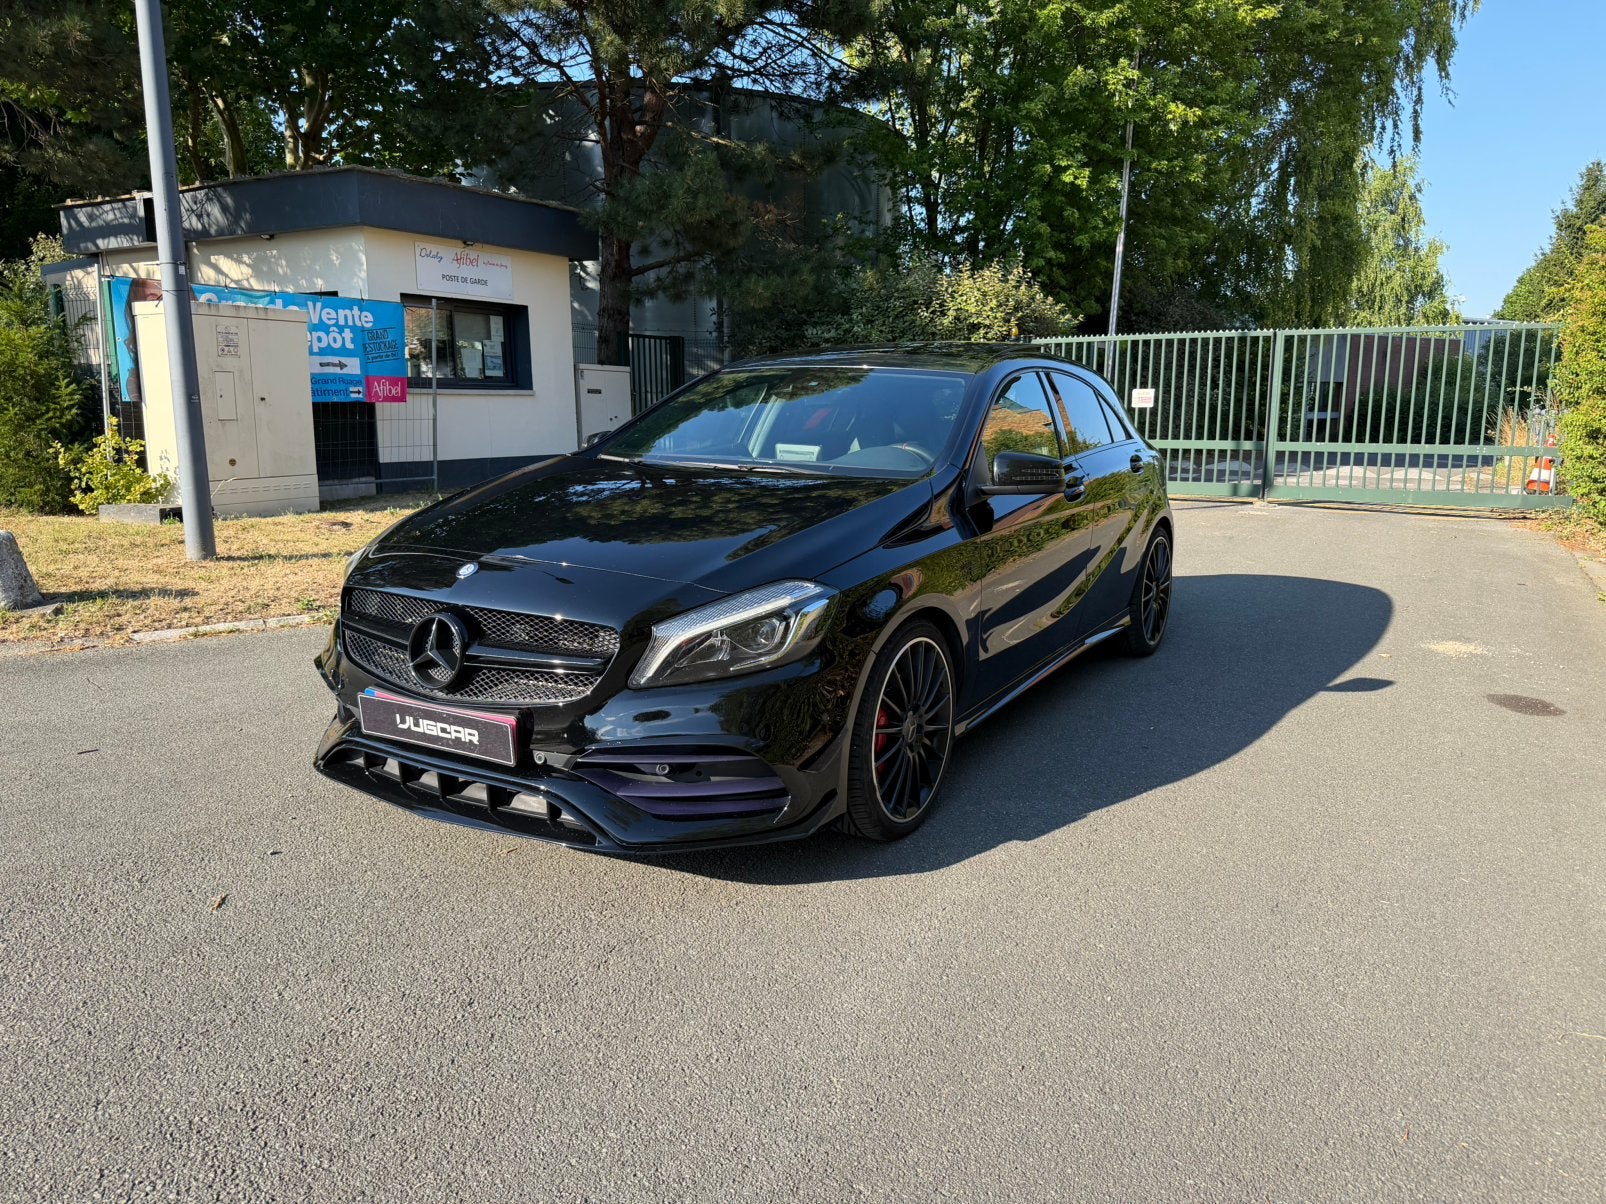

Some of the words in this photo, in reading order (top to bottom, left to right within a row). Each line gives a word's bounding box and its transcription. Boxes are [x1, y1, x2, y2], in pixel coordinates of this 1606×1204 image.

[451, 250, 480, 269] Afibel
[441, 274, 460, 283] POSTE
[461, 276, 469, 284] DE
[469, 278, 489, 287] GARDE
[307, 301, 374, 328] Vente
[306, 326, 355, 352] pôt
[311, 387, 348, 397] âtiment
[371, 379, 401, 401] Afibel
